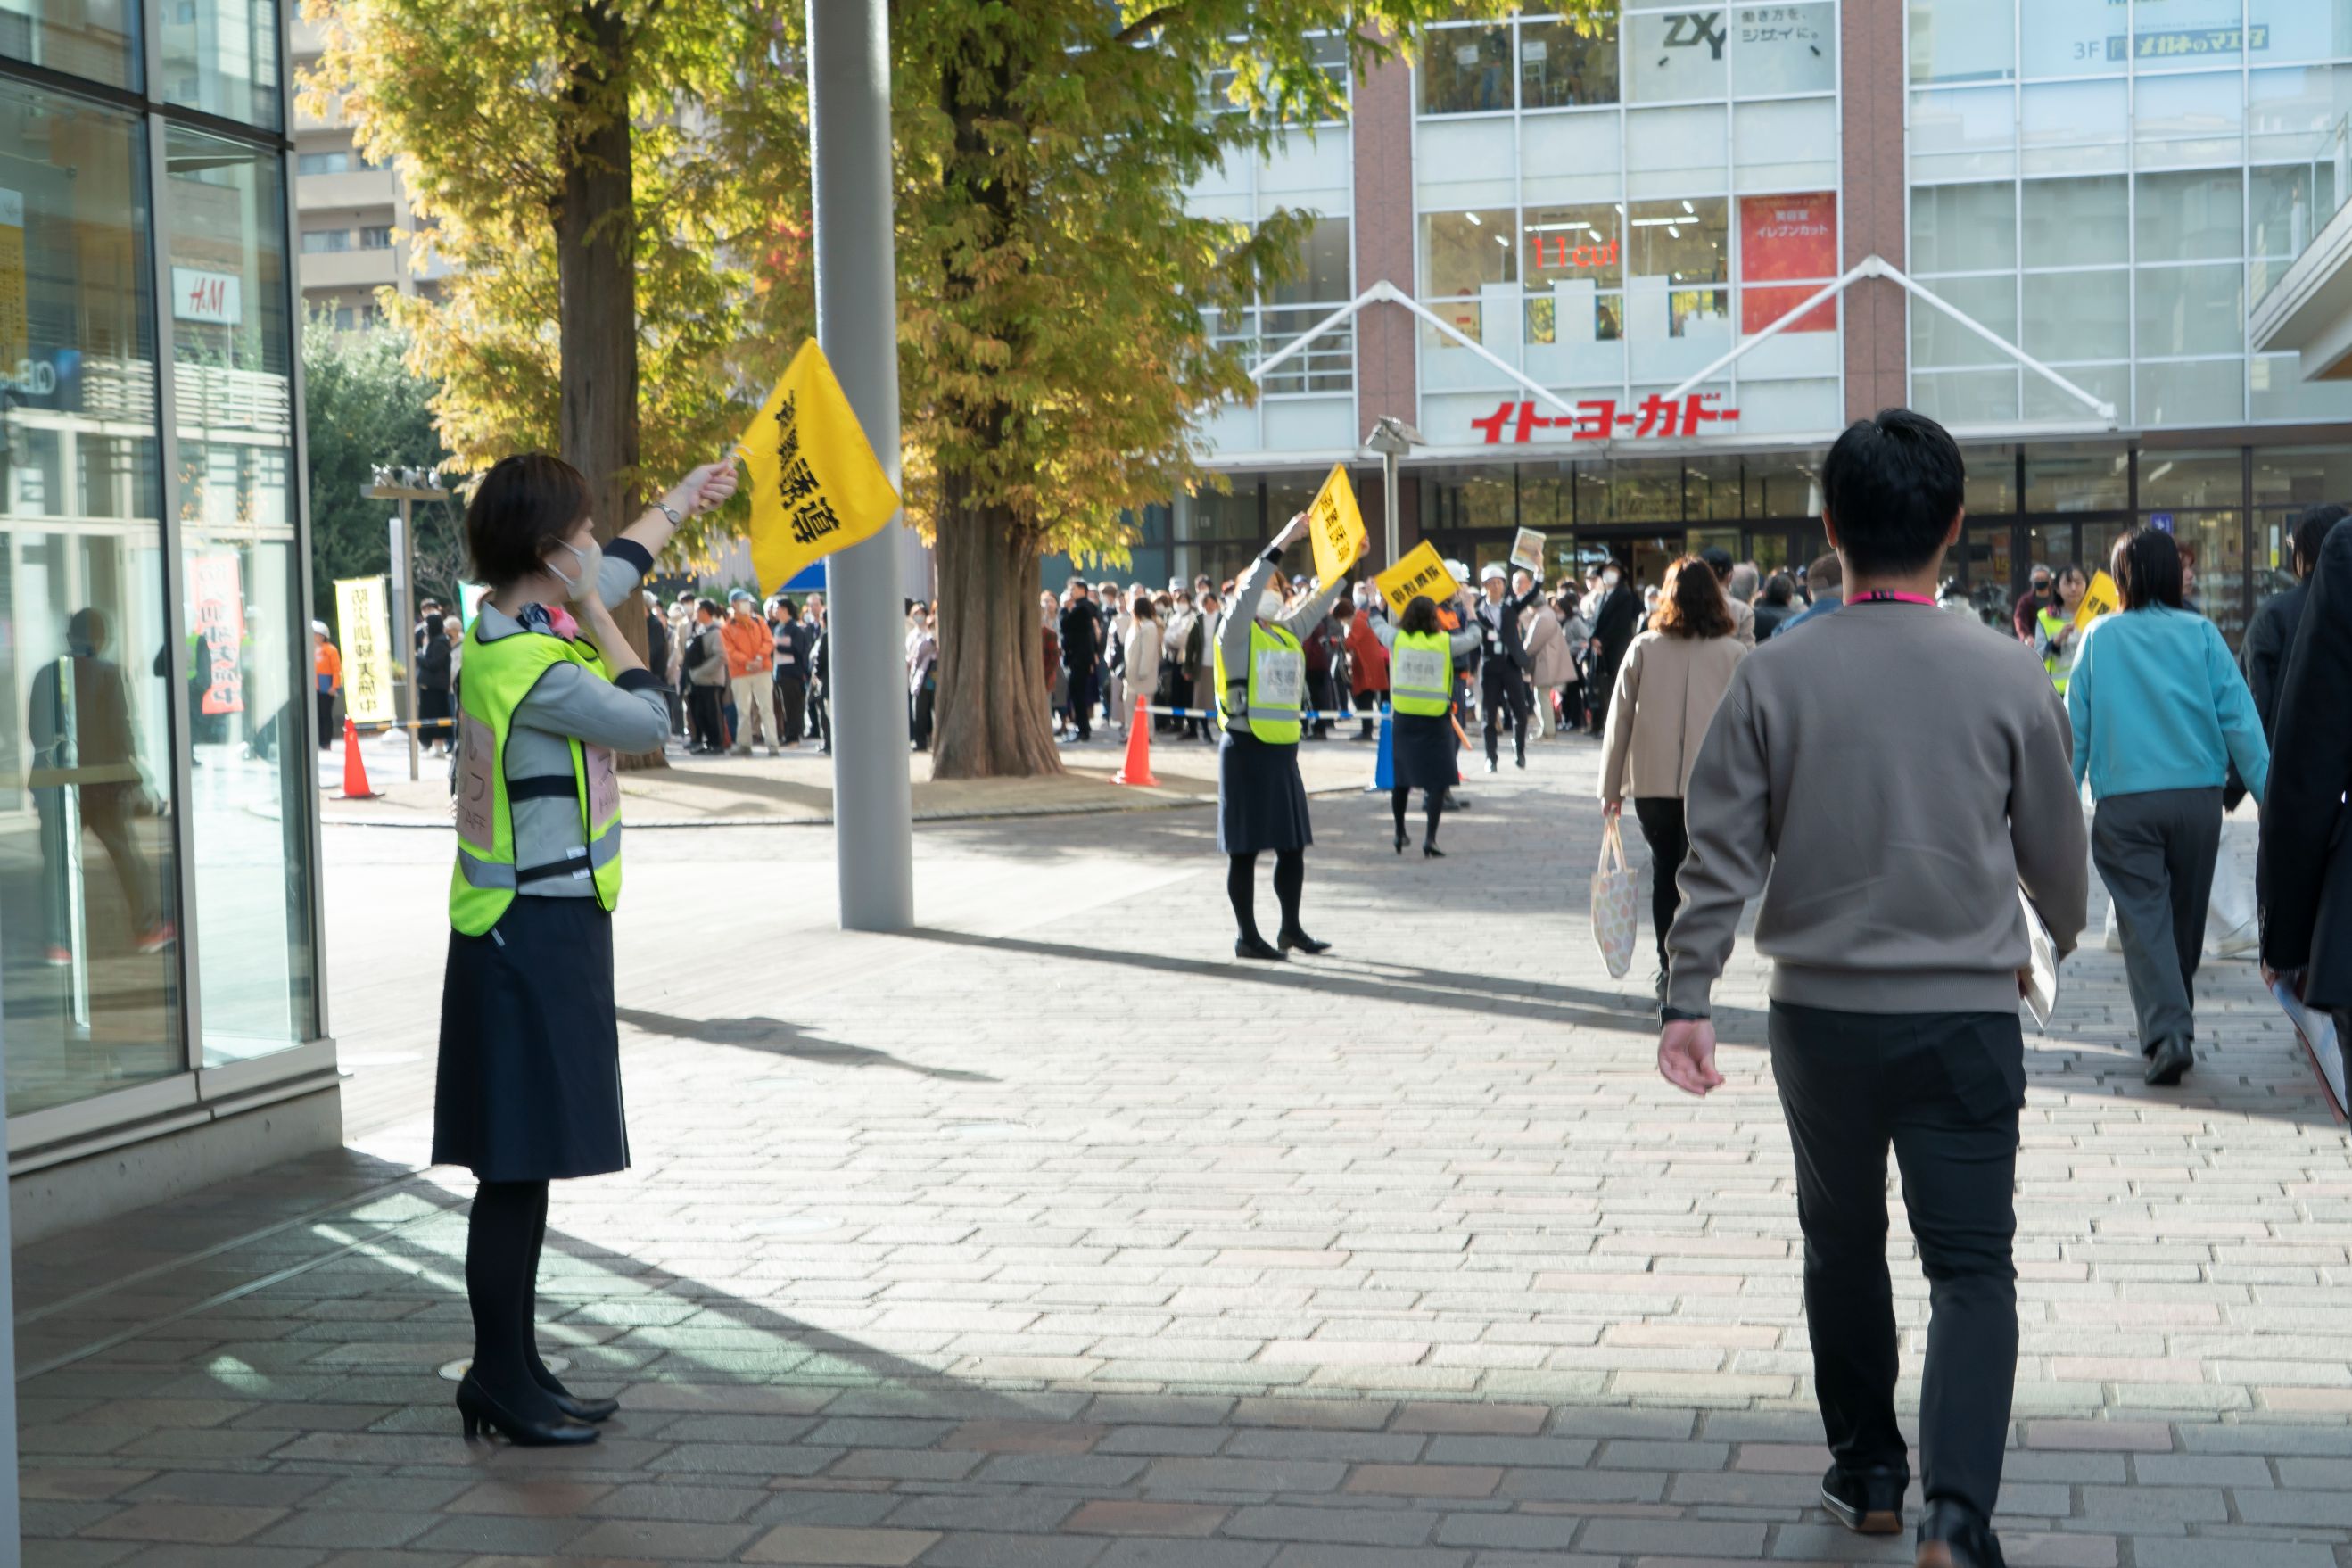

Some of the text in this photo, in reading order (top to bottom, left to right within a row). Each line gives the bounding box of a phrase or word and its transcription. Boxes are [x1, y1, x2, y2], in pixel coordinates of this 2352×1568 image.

[2073, 41, 2100, 60] 3F
[1471, 392, 1740, 444] イトーヨーカドー
